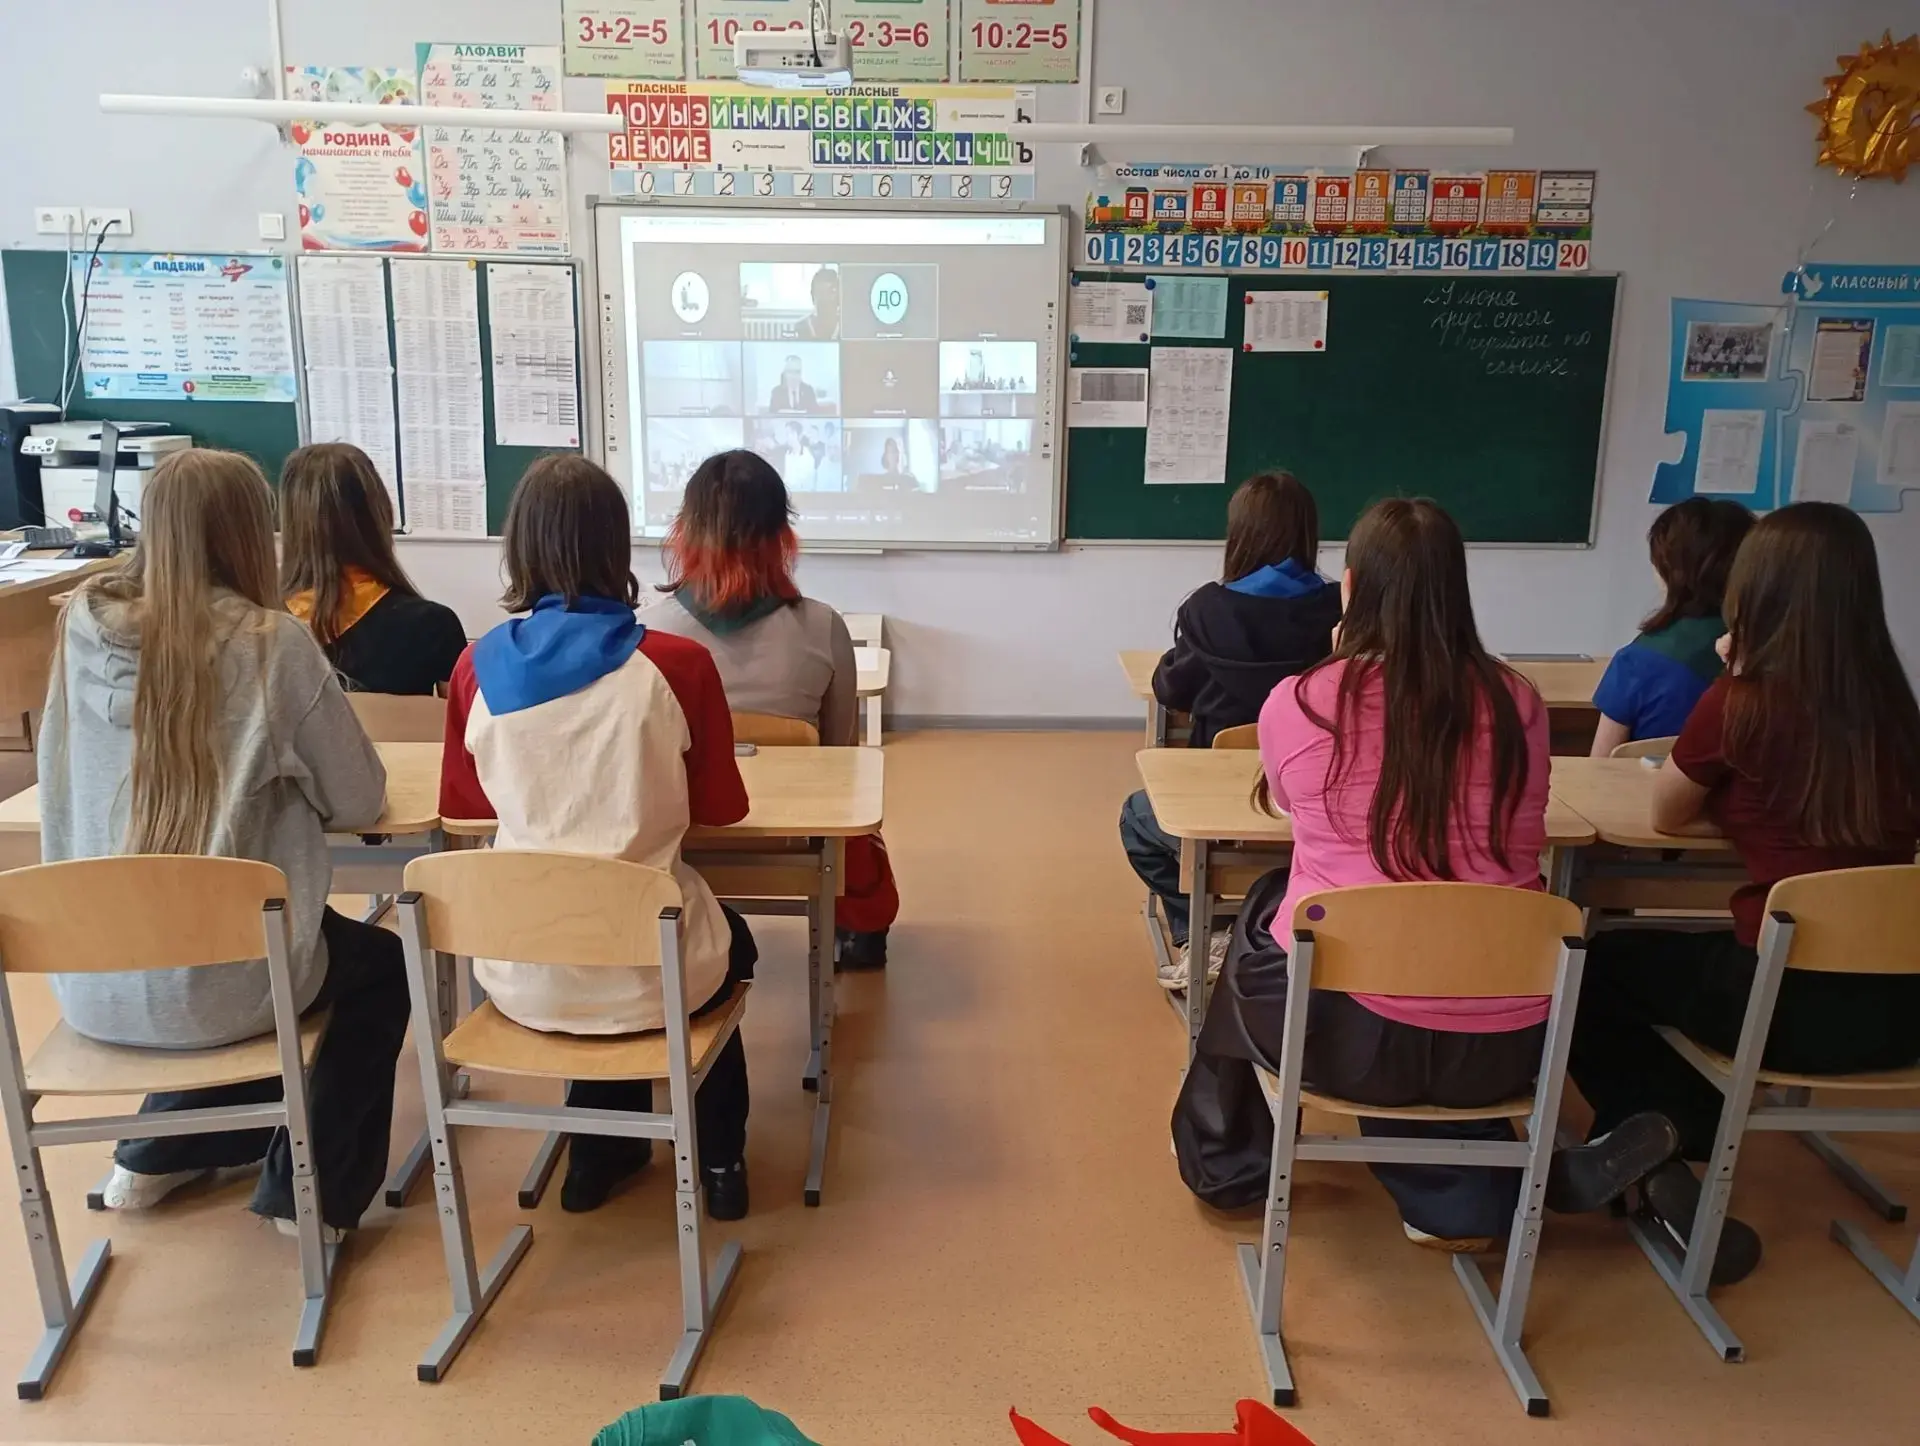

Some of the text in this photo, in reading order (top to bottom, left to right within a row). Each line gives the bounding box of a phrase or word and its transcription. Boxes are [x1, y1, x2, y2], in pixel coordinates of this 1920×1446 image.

[578, 16, 668, 44] 3+2=5
[971, 22, 1068, 49] 10:2=5
[454, 46, 526, 58] АЛФАВИТ
[628, 84, 687, 94] ГЛАСНЫЕ
[826, 87, 899, 97] СОГЛАСНЫЕ
[323, 133, 391, 147] РОДИНА
[1115, 167, 1159, 178] состав
[1163, 167, 1200, 178] числа
[1204, 168, 1217, 178] от
[1234, 169, 1250, 180] до
[1255, 167, 1270, 179] 10
[641, 172, 1012, 198] 0 1 2 3 4 5 6 7 8 9
[1088, 237, 1587, 267] 0 1 2 3 4 5 6 7 8 9 10 11 12 13 14 15 16 17 18 19 20
[153, 260, 205, 273] ПАДЕЖИ
[1831, 273, 1908, 289] КЛАССНЫЙ
[877, 290, 902, 309] ДО
